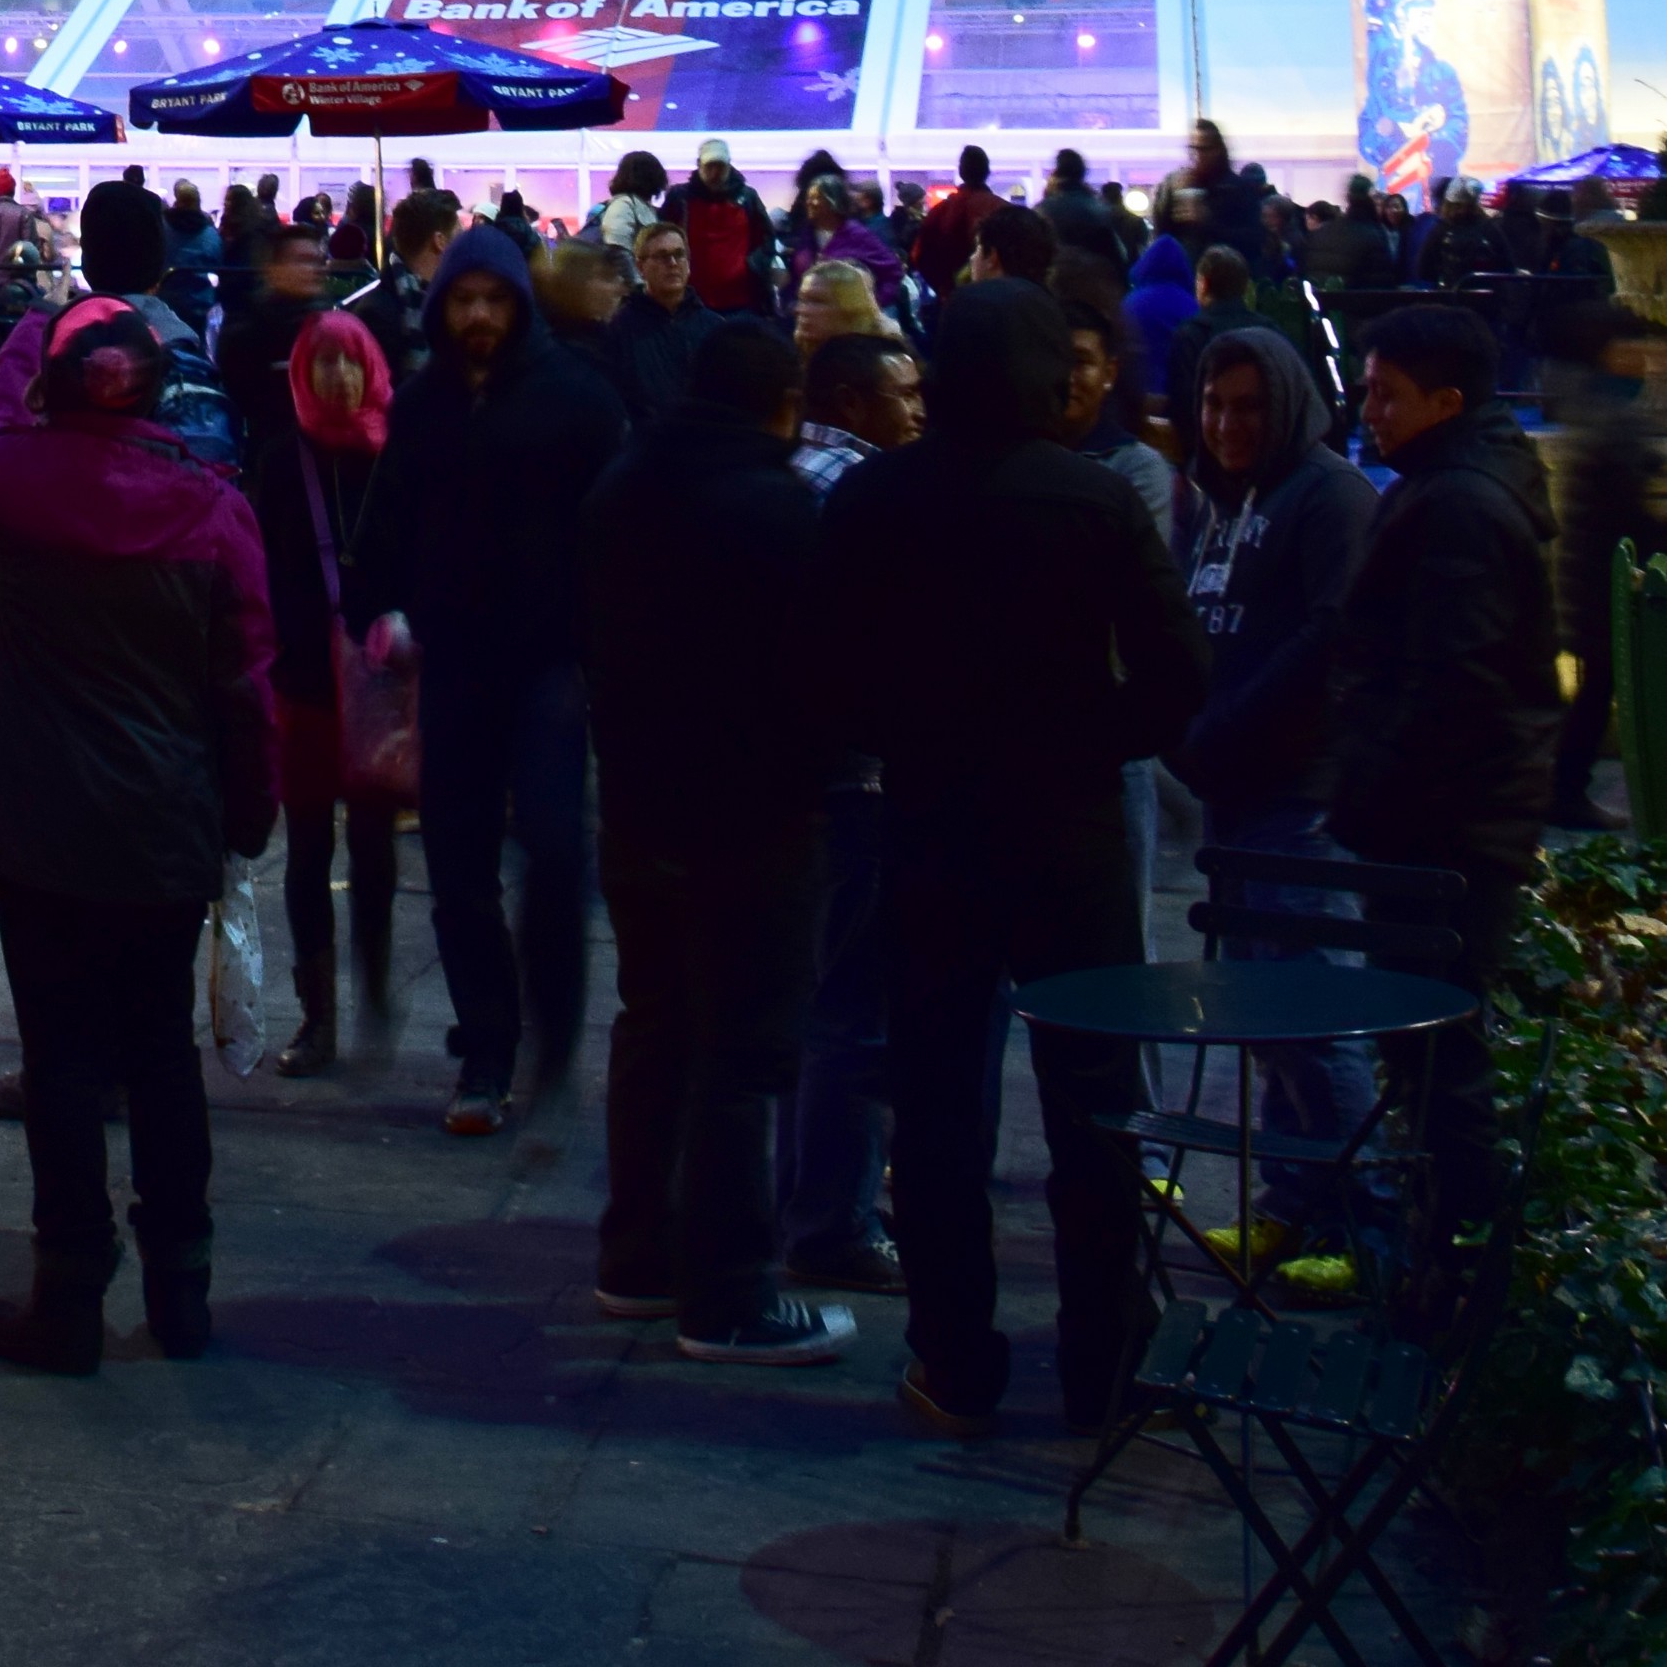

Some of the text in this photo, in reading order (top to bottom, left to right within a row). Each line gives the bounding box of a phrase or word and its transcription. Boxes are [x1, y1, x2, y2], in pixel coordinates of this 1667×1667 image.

[308, 80, 401, 94] Bank of America
[491, 84, 545, 99] BRYANT
[151, 95, 196, 109] BRYANT
[308, 94, 383, 107] Winter Village
[16, 121, 96, 132] BRYANT PARK
